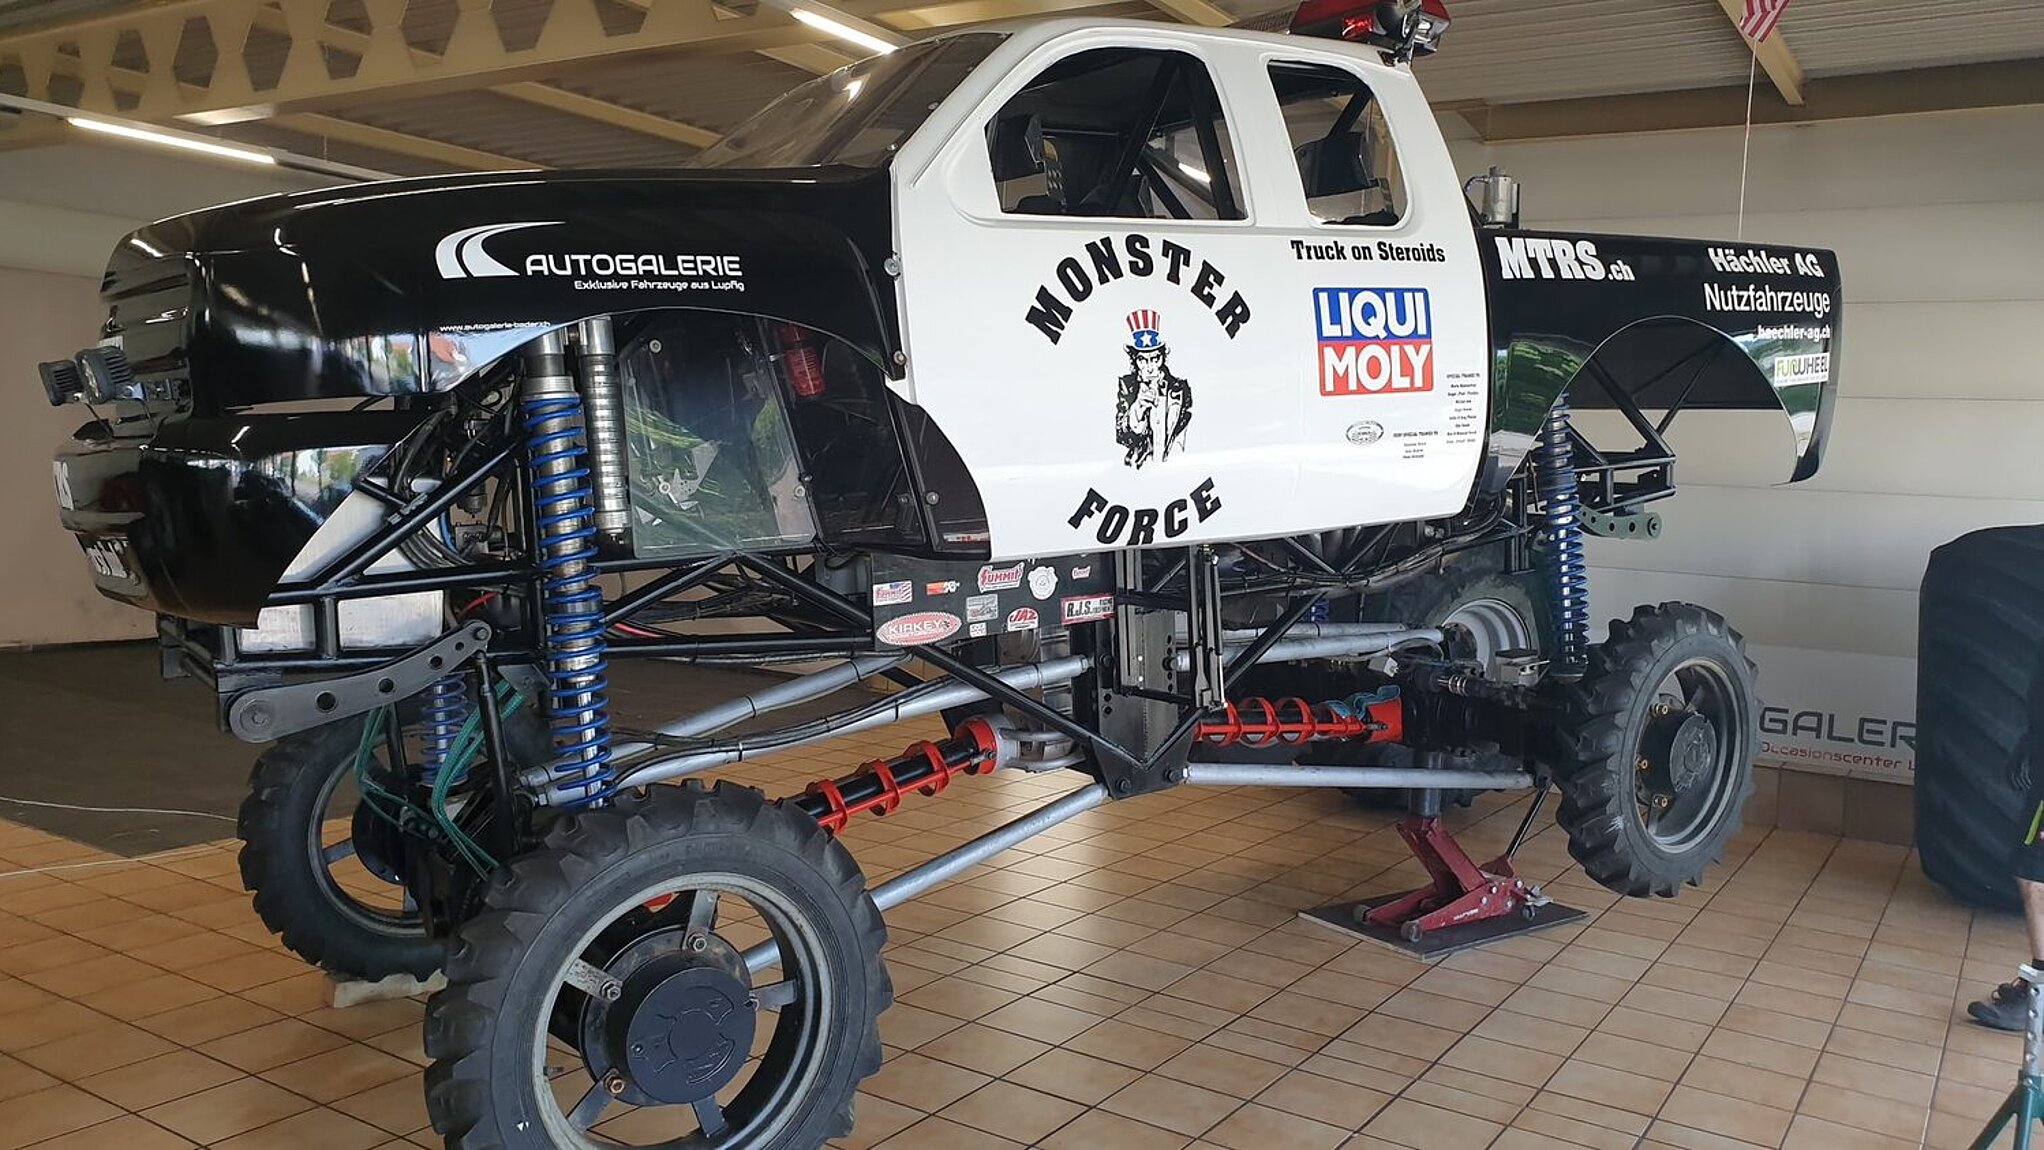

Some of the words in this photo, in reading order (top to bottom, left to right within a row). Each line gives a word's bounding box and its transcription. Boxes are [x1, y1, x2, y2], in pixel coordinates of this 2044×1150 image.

[525, 253, 743, 277] AUTOGALERIE
[1290, 240, 1347, 261] Truck
[1352, 244, 1374, 261] on
[1376, 240, 1447, 263] Steroids
[1494, 236, 1636, 281] MTRS.ch
[1707, 247, 1791, 276] Hächler
[1794, 252, 1826, 279] AG
[573, 280, 629, 291] Exklusive
[630, 279, 689, 292] Fahrzeuge
[690, 281, 710, 290] aus
[1025, 234, 1251, 345] MONSTER
[1703, 282, 1831, 318] Nutzfahrzeuge
[1317, 289, 1428, 339] LIQUI
[1322, 343, 1432, 392] MOLY
[1067, 476, 1222, 546] FORCE
